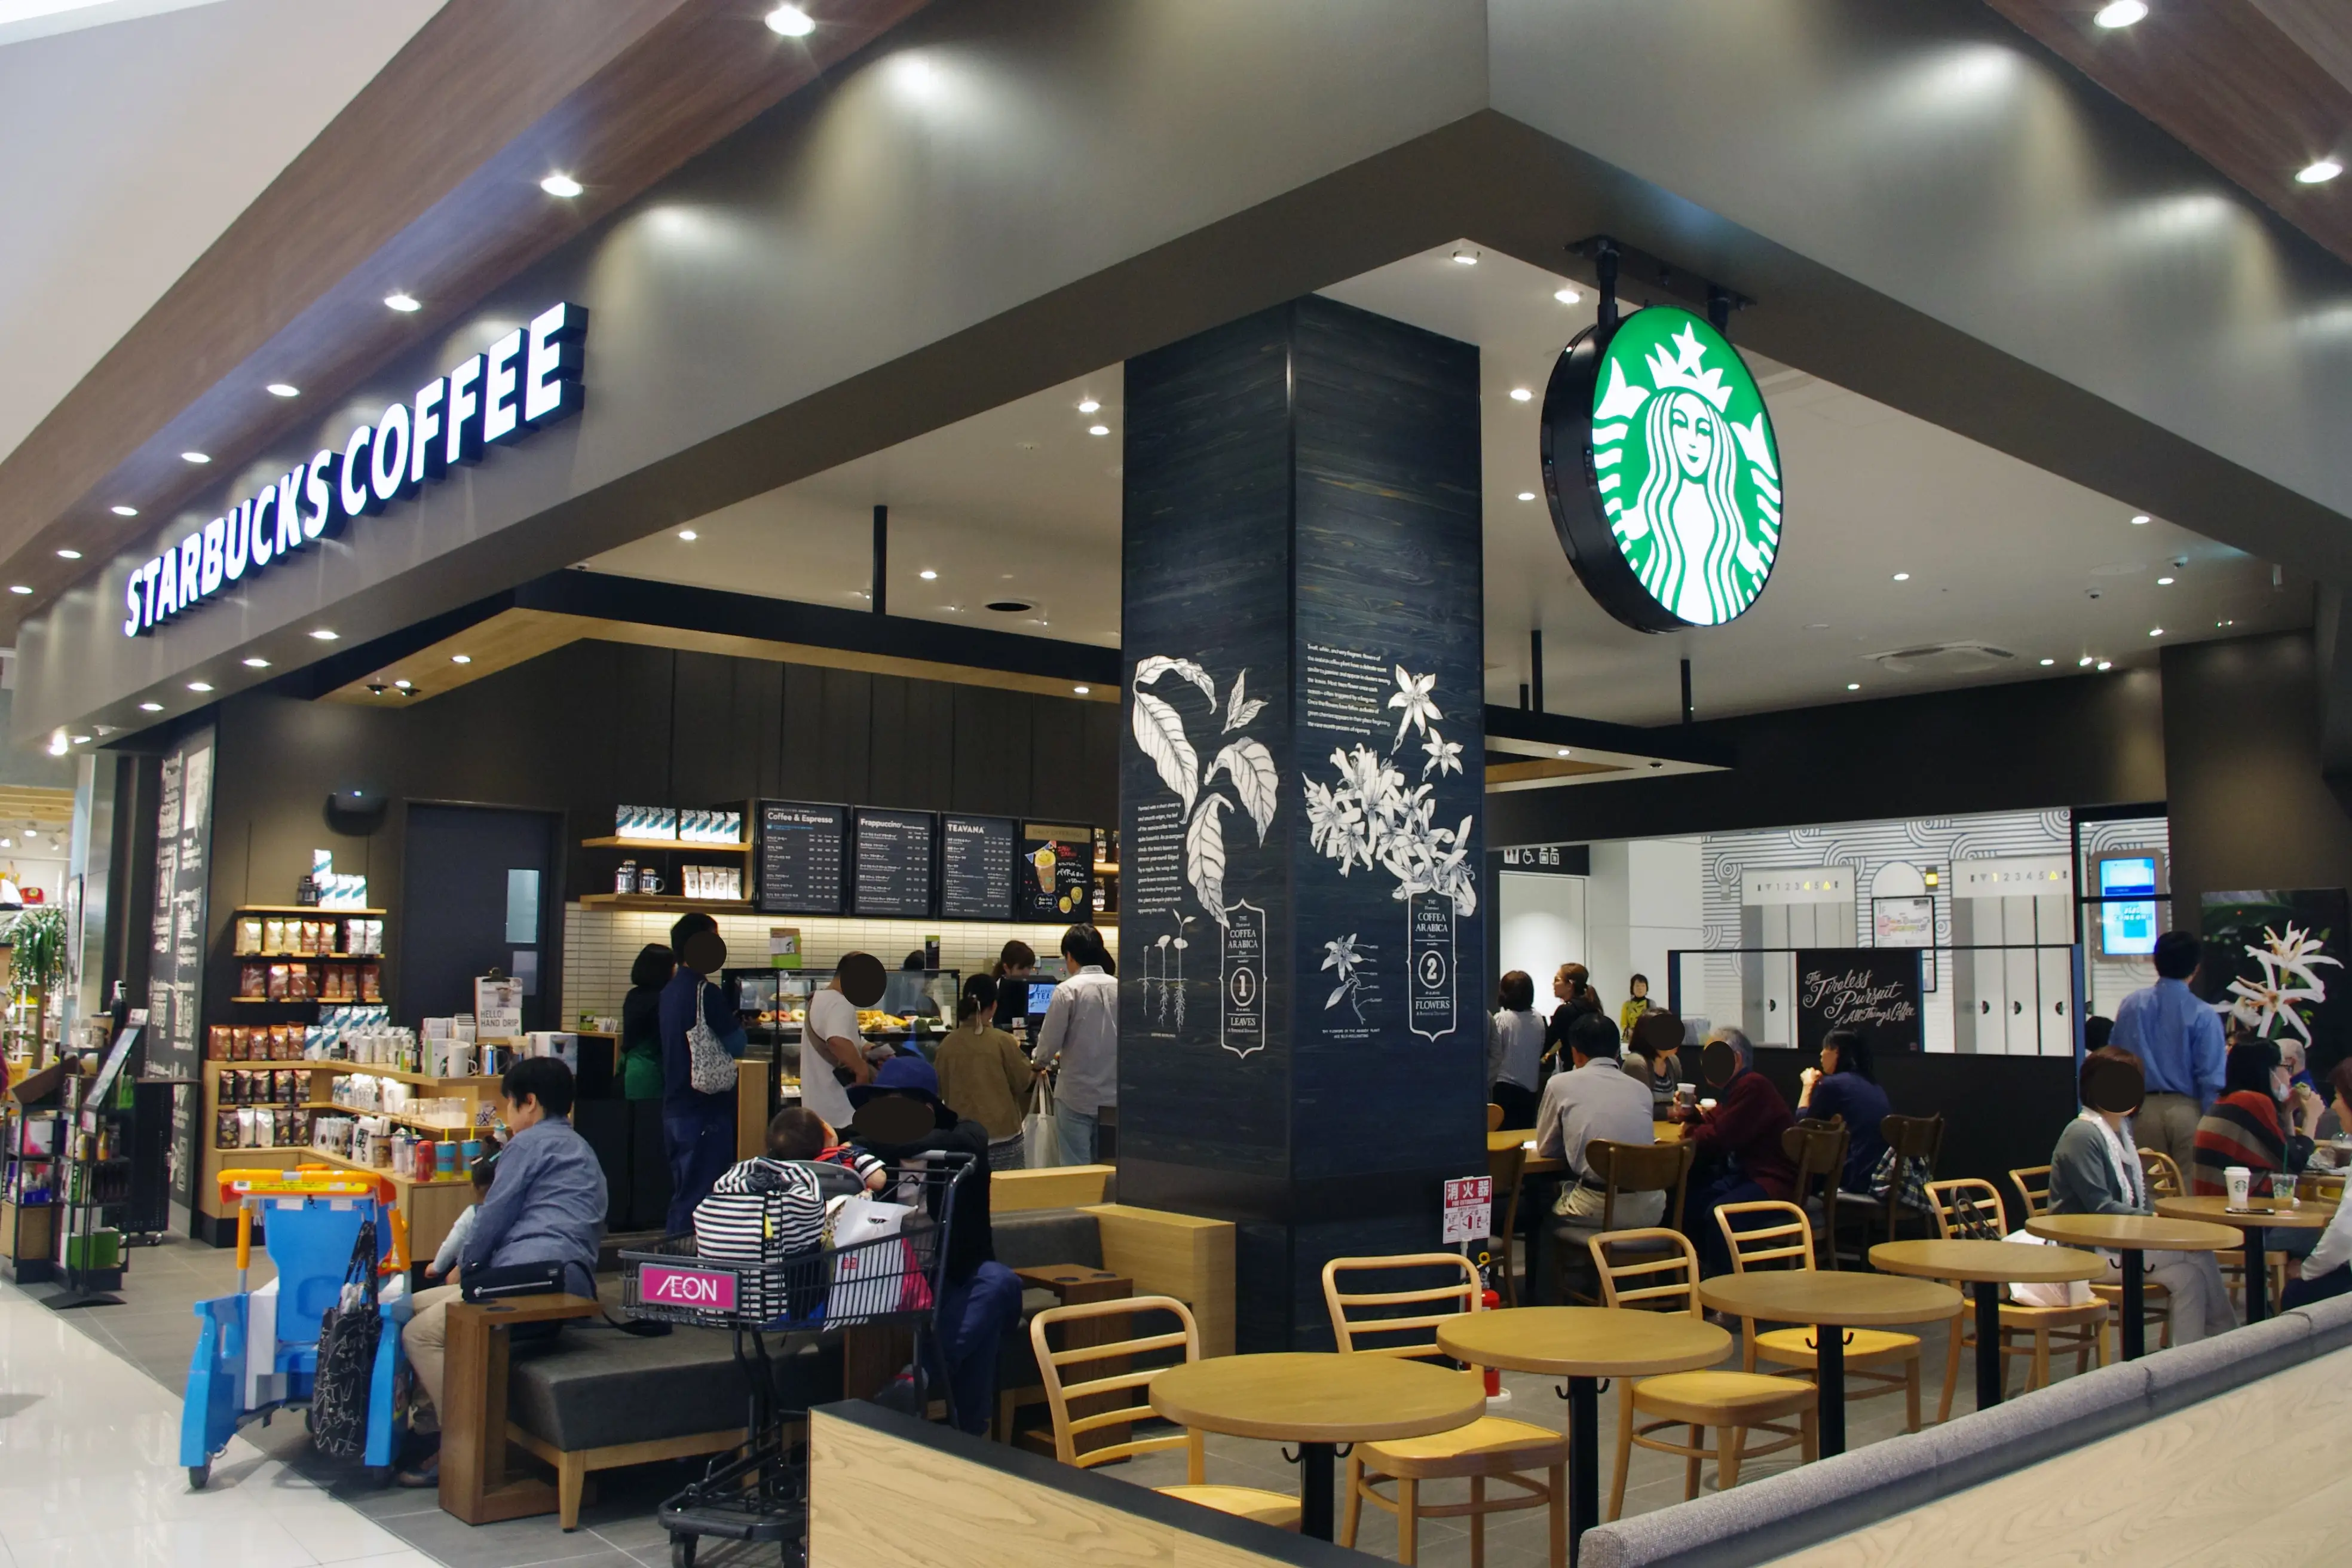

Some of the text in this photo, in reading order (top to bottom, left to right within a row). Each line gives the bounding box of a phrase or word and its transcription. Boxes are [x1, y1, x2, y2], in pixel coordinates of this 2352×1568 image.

[124, 302, 566, 638] STARBUCKS COFFEE
[768, 813, 792, 821] Coffee
[802, 816, 833, 824] Espresso
[1993, 872, 1998, 882] 1
[2004, 873, 2010, 881] 2
[2015, 872, 2020, 881] 3
[2039, 871, 2044, 880] 5
[1795, 882, 1799, 890] 3
[1814, 881, 1819, 890] 5
[1417, 912, 1446, 921] COFFEA
[1230, 929, 1256, 938] COFFEA
[1415, 923, 1448, 932] ARABICA
[1227, 939, 1258, 948] ARABICA
[1426, 957, 1437, 980] 2
[1805, 970, 1821, 985] The
[1239, 975, 1247, 997] 1
[1803, 969, 1873, 1008] Tireless
[1416, 1000, 1450, 1009] FLOWERS
[1824, 981, 1904, 1019] Pursuit
[1843, 1009, 1863, 1024] All
[1861, 1006, 1891, 1027] Things
[1447, 1180, 1489, 1200] 消火器
